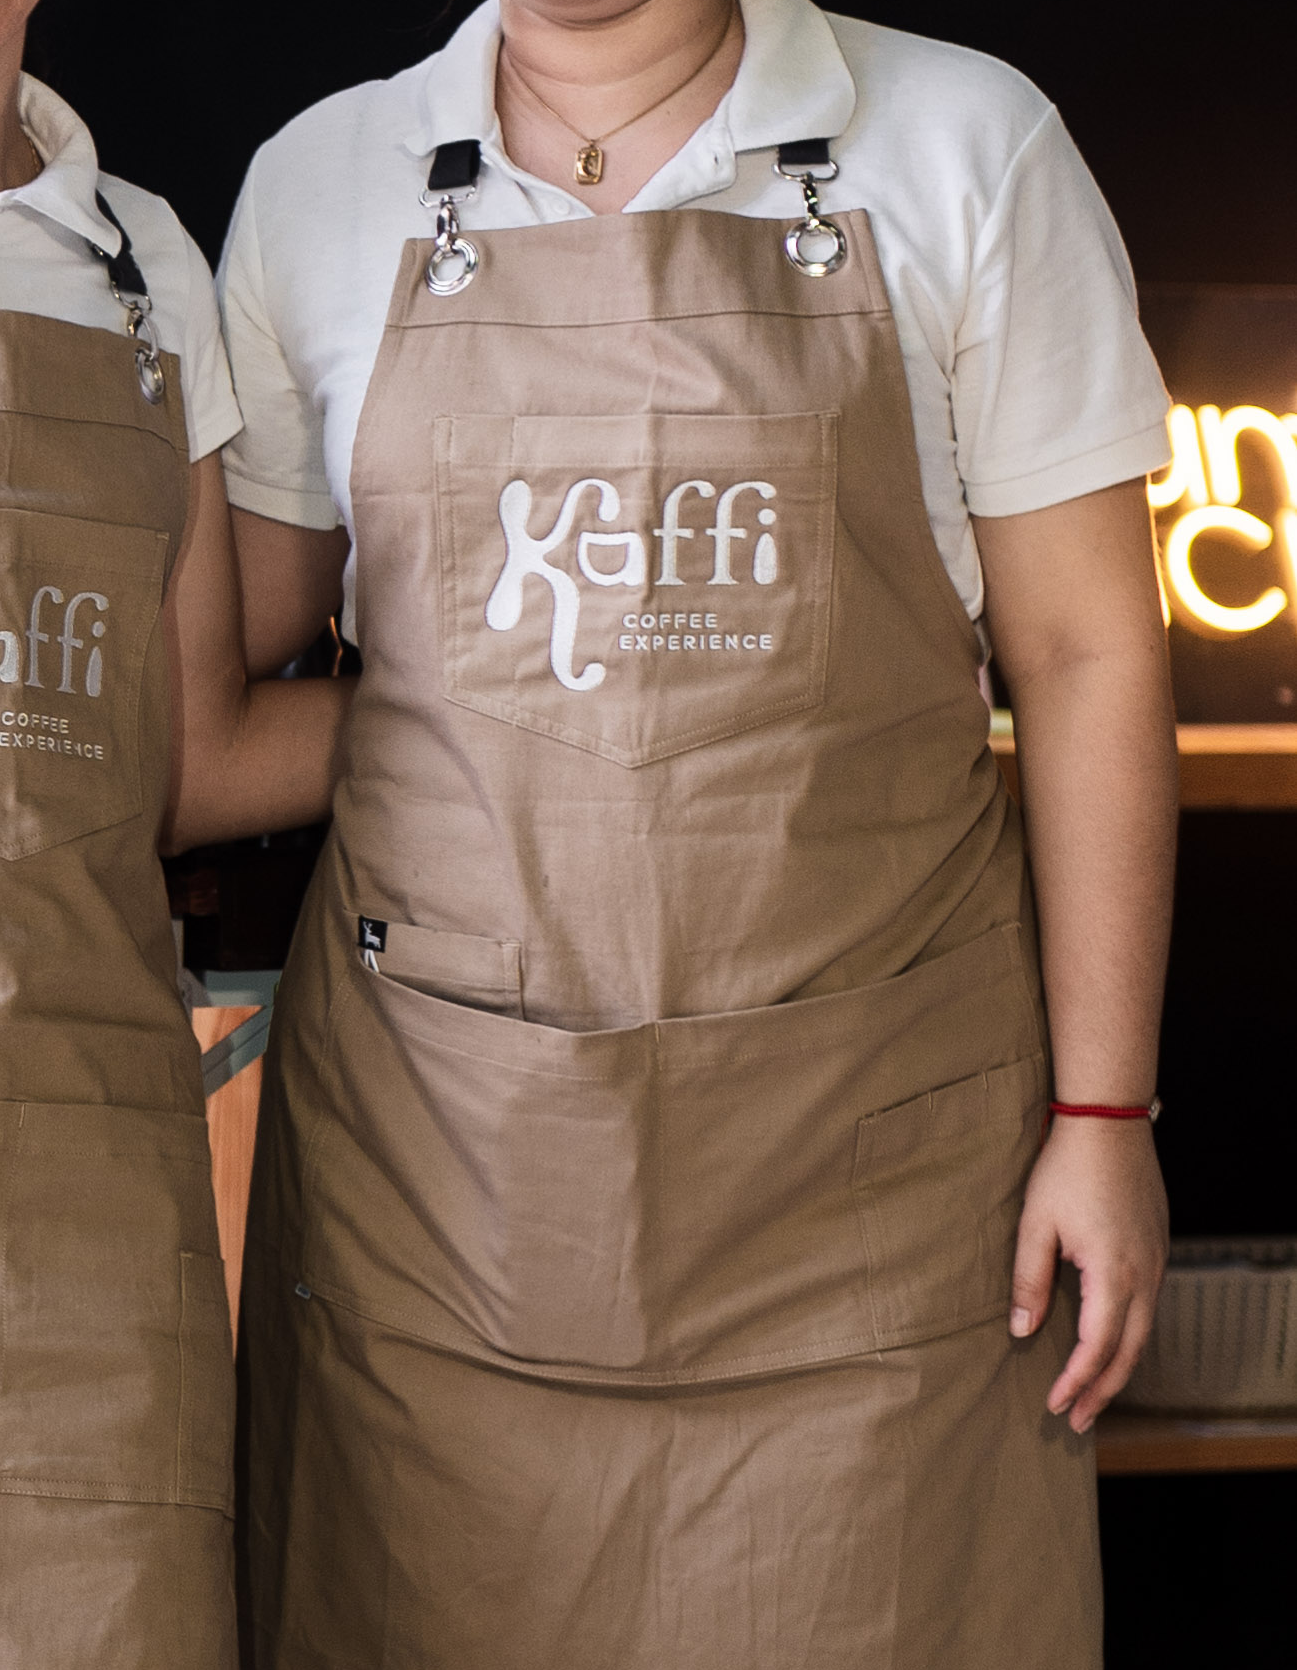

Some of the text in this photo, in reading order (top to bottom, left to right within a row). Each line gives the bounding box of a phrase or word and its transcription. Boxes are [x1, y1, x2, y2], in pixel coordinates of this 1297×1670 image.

[485, 478, 777, 692] Kaffi
[621, 612, 719, 630] COFFEE
[618, 632, 773, 652] EXPERIENCE
[0, 710, 70, 734] COFFEE
